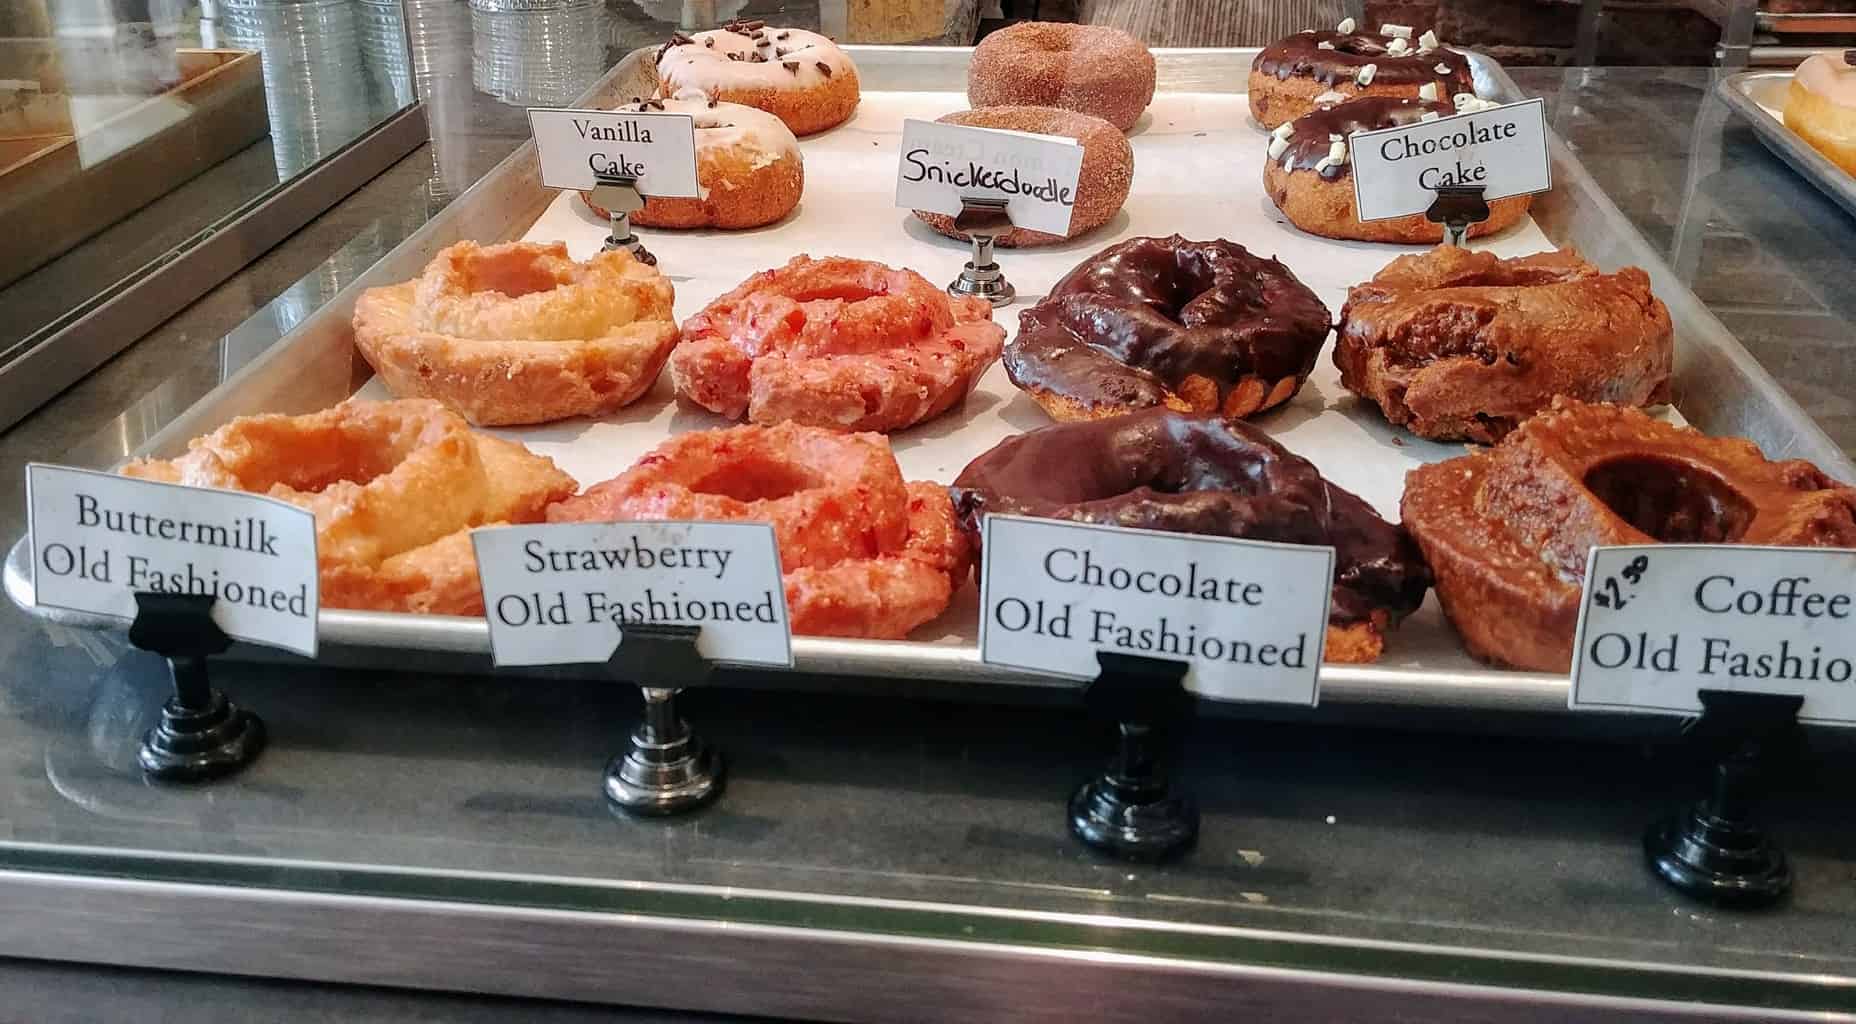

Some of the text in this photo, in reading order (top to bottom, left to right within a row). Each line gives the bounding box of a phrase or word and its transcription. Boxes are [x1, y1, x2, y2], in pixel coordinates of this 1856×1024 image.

[572, 118, 653, 143] Vanilla
[1380, 121, 1517, 161] Chocolate
[588, 152, 645, 176] Cake
[903, 149, 1074, 206] Snickerdoodle
[1418, 161, 1487, 190] Cake
[75, 493, 279, 556] Buttermilk
[524, 535, 733, 579] Strawberry
[1044, 548, 1264, 606] Chocolate
[42, 543, 308, 617] Old Fashioned
[1695, 575, 1851, 619] Coffee
[497, 589, 780, 627] Old Fashioned
[995, 597, 1307, 669] Old Fashioned
[1590, 632, 1856, 683] Old Fashio
